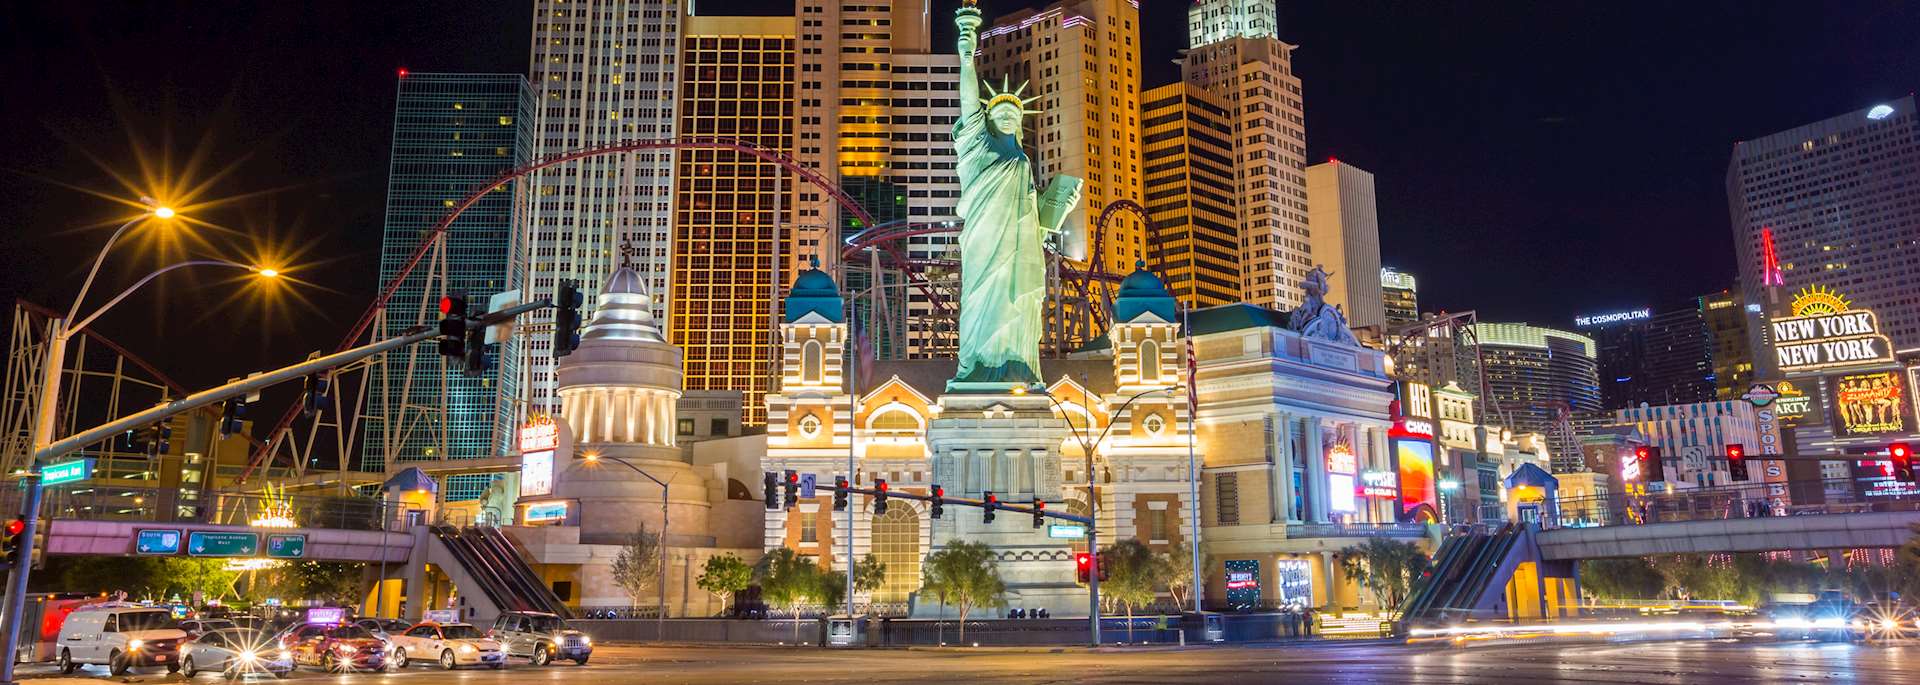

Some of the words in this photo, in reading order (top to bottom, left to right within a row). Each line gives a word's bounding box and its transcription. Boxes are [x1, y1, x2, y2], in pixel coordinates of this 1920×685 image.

[1576, 317, 1591, 326] THE
[1591, 308, 1649, 324] COSMOPOLITAN
[1772, 318, 1816, 341] NEW
[1818, 313, 1874, 337] YORK
[1776, 343, 1819, 366] NEW
[1822, 338, 1878, 362] YORK
[1775, 402, 1811, 415] ARTY.
[1758, 410, 1781, 477] SPORTS
[1768, 483, 1788, 517] BAR
[273, 541, 282, 549] 15
